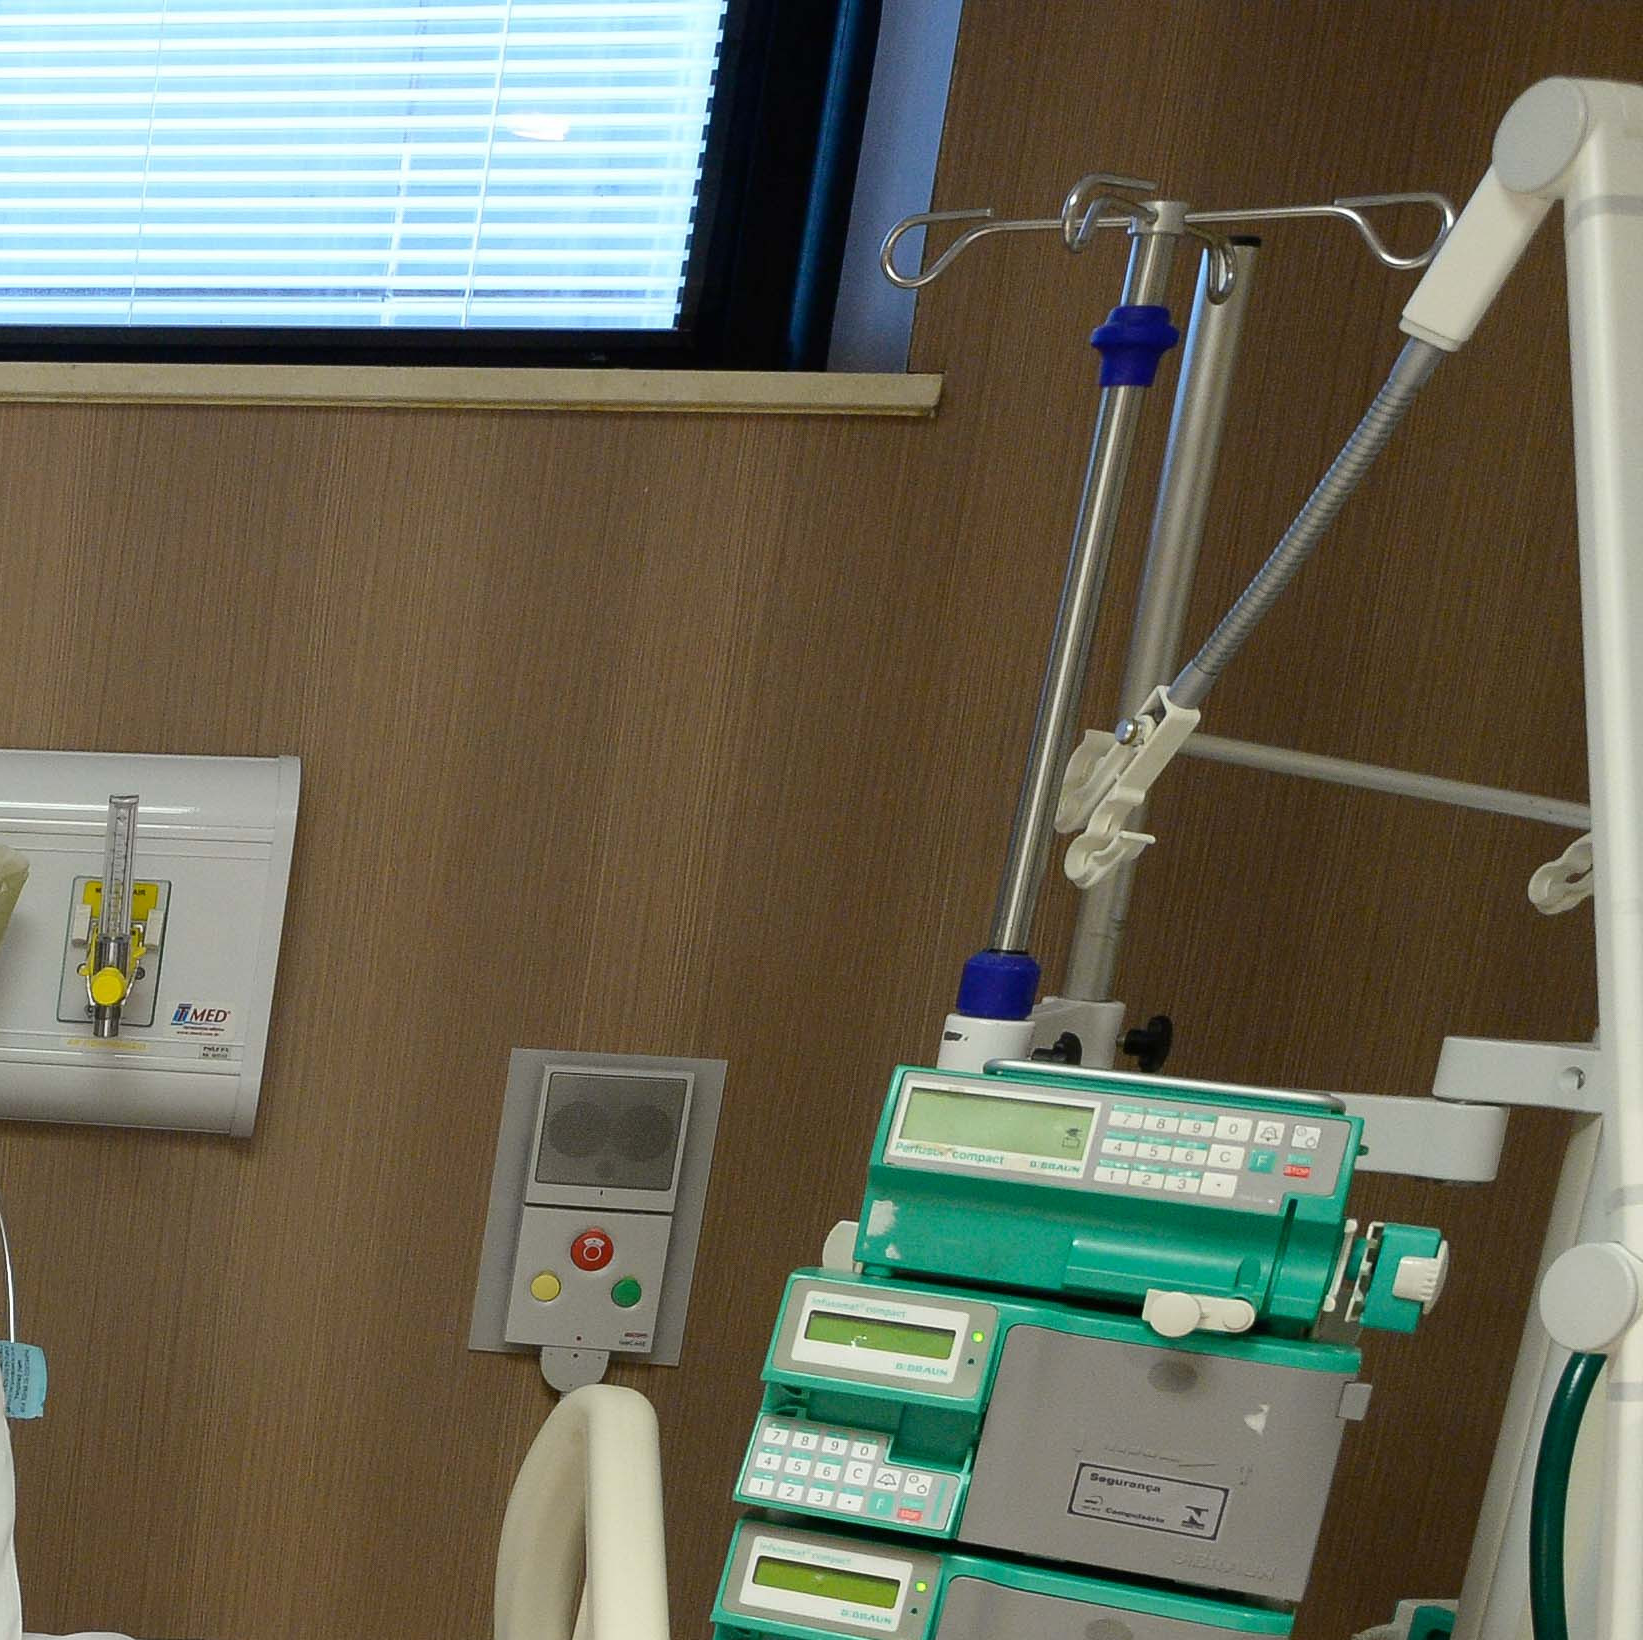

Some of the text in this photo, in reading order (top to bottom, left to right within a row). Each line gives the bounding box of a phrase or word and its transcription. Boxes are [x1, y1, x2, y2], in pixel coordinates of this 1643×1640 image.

[1156, 1118, 1166, 1129] 8
[1192, 1122, 1202, 1134] 9
[951, 1150, 1004, 1165] compact
[1149, 1145, 1158, 1157] 5
[1185, 1150, 1194, 1162] 6
[1220, 1151, 1231, 1163] C
[1141, 1174, 1151, 1186] 2
[1177, 1178, 1186, 1190] 3
[801, 1435, 809, 1446] 8
[831, 1440, 839, 1451] 9
[794, 1461, 802, 1472] 5
[823, 1466, 830, 1477] 6
[853, 1468, 863, 1480] C
[1089, 1472, 1162, 1495] Segurança
[786, 1486, 794, 1497] 2
[816, 1492, 823, 1503] 3
